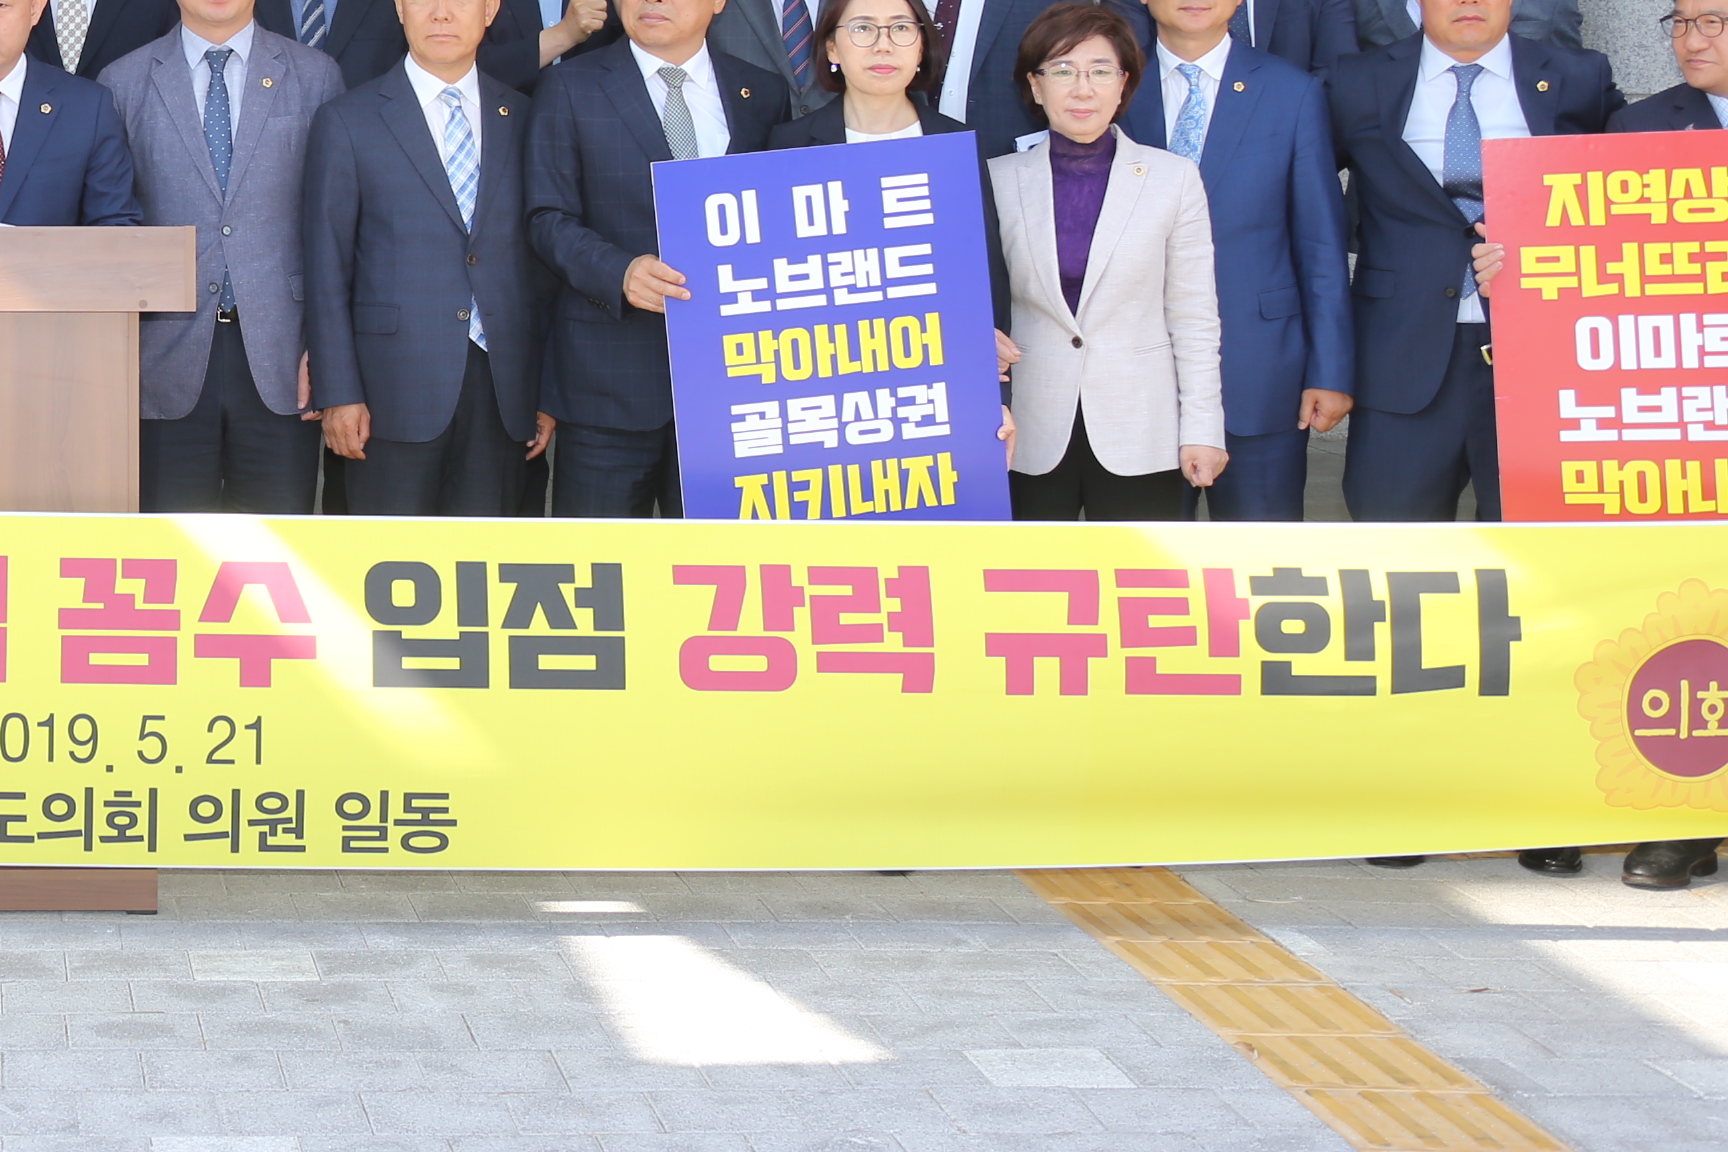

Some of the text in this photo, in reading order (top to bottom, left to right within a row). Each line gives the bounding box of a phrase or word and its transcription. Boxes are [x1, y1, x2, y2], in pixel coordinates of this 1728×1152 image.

[717, 243, 938, 317] 노브랜드
[722, 312, 944, 385] 막아내어
[730, 382, 951, 459] 골목상권
[734, 451, 958, 519] 지키내자
[58, 557, 317, 688] 꼼수
[364, 560, 626, 690] 입점
[672, 564, 936, 694] 강력
[982, 567, 1522, 697] 규탄한다
[204, 714, 264, 766] 21
[183, 788, 306, 854] 의원
[334, 789, 458, 855] 일동
